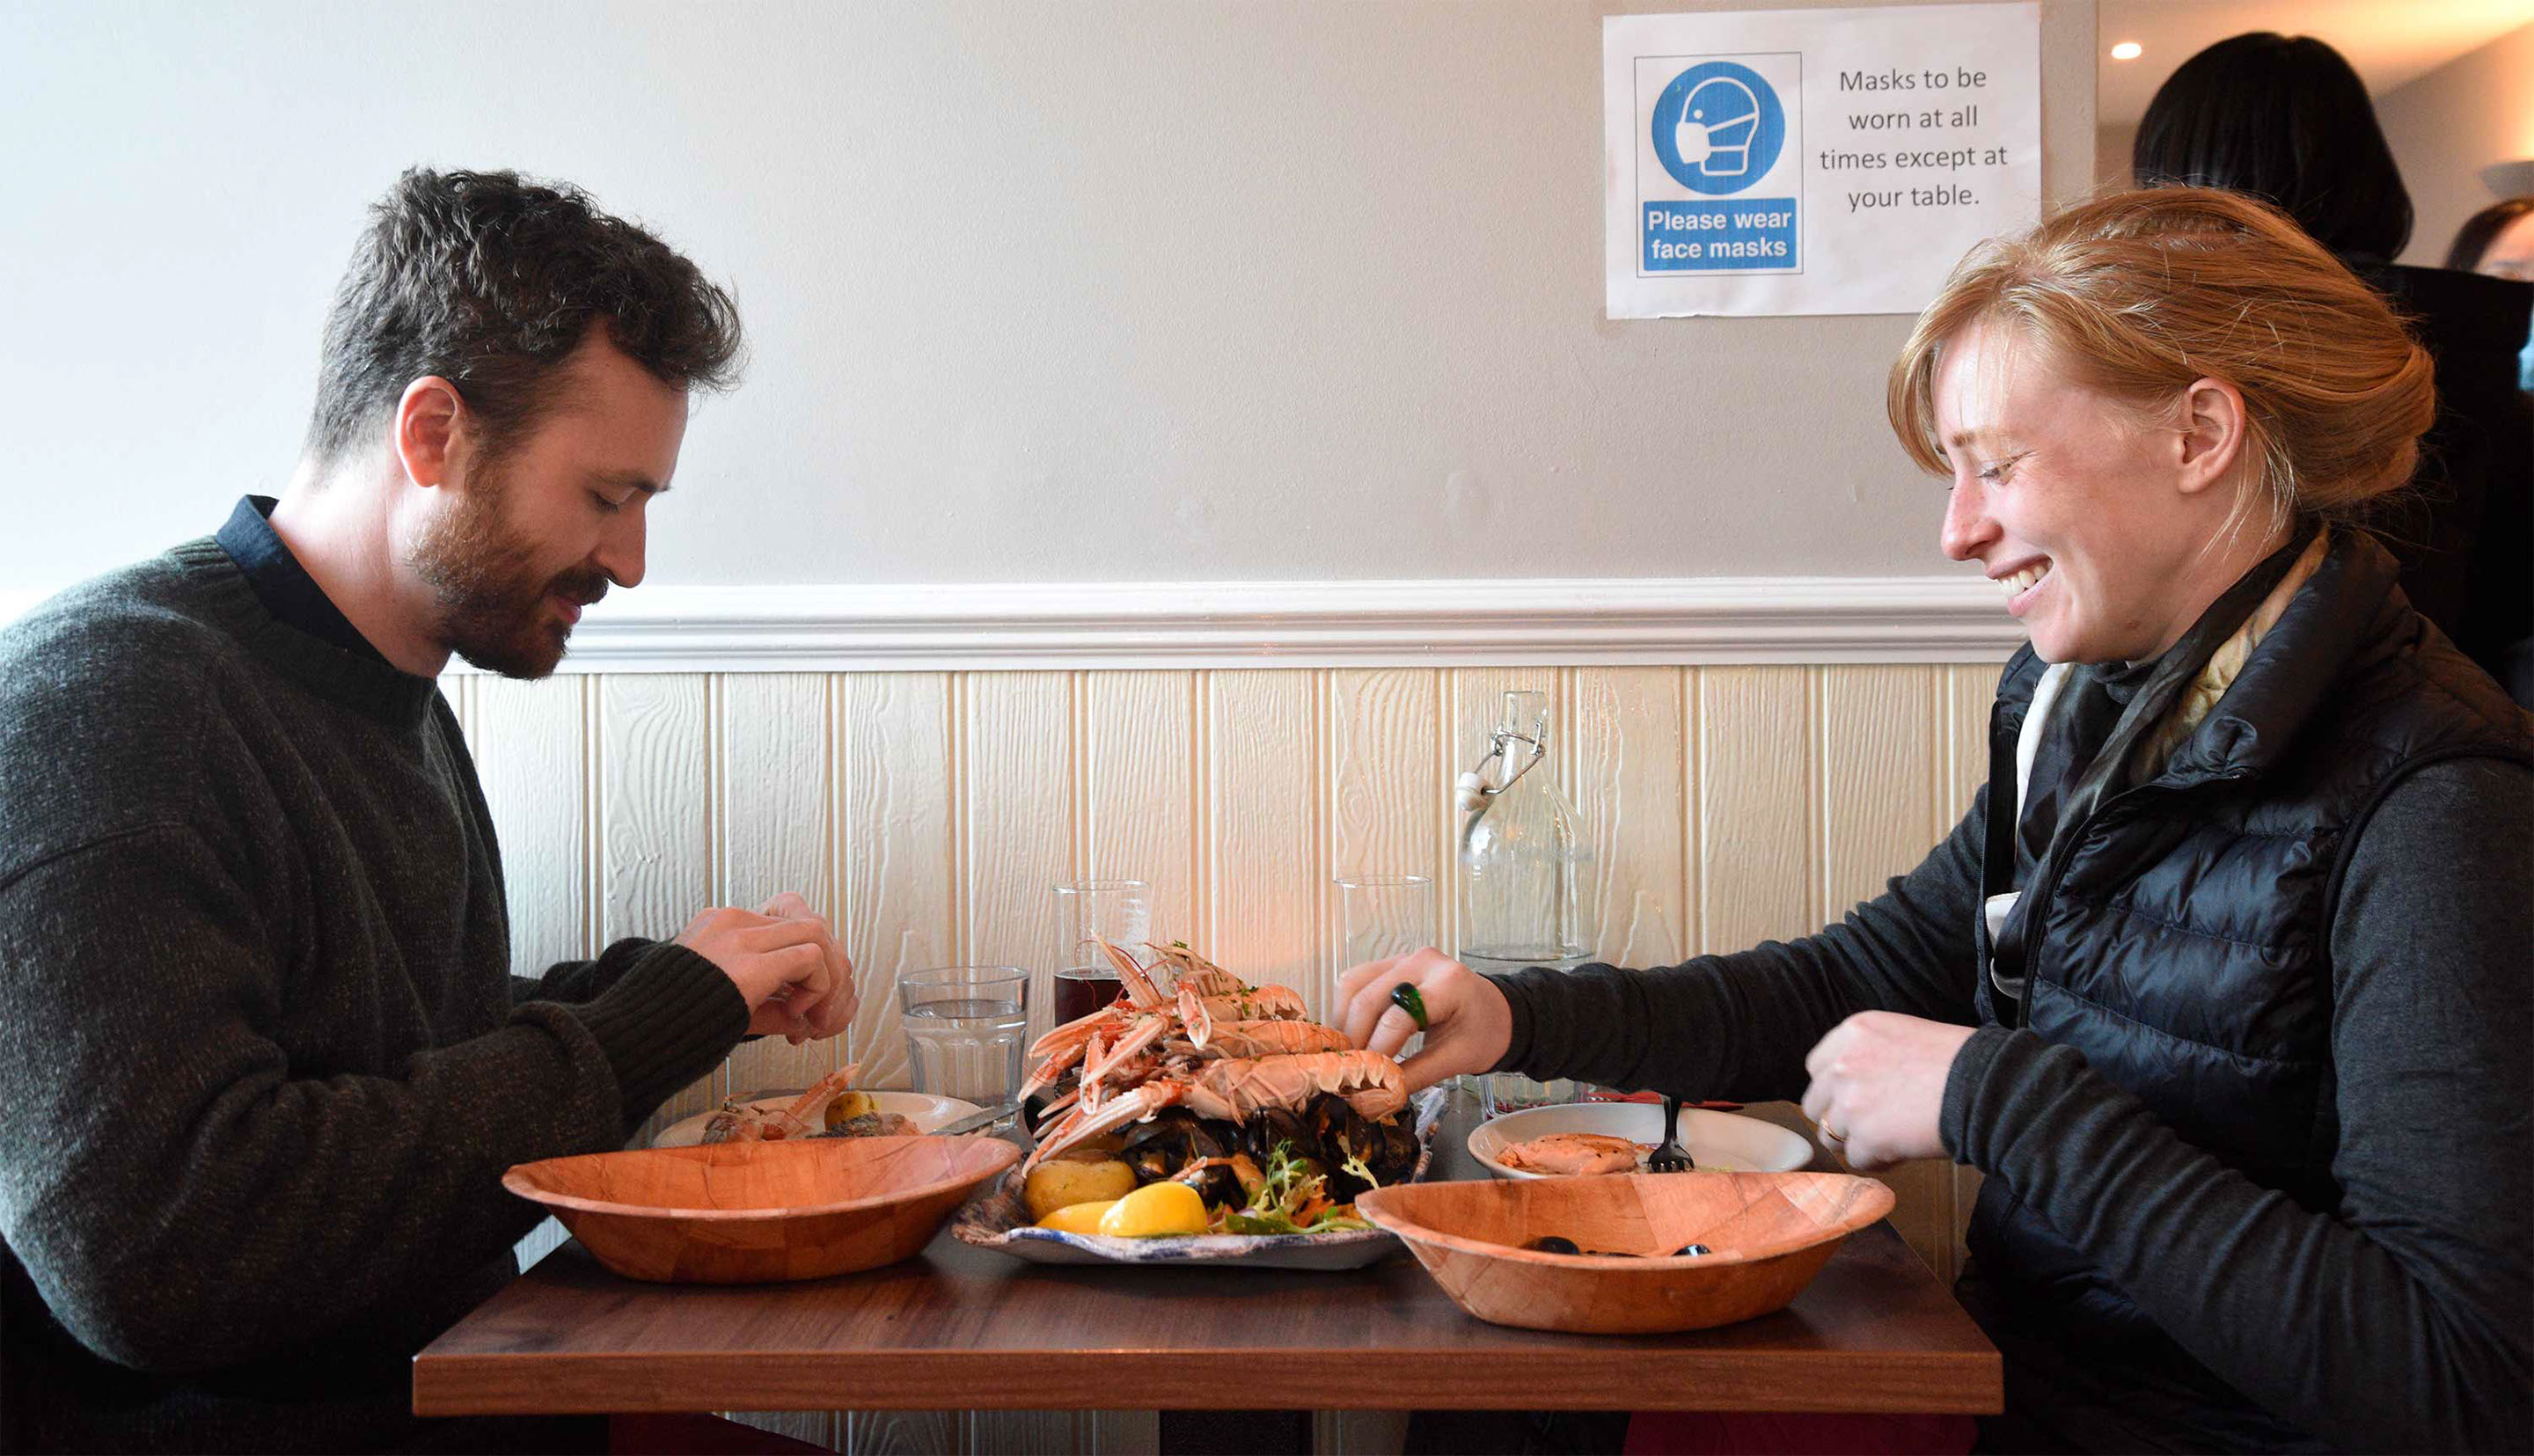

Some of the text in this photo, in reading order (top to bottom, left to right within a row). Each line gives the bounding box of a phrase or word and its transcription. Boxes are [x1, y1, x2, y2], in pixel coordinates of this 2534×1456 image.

[1841, 66, 1987, 91] Masks to be
[1849, 105, 1977, 130] worn at all
[1820, 146, 2008, 172] times except at
[1848, 184, 1979, 213] your table.
[1648, 210, 1792, 230] Please wear
[1651, 236, 1787, 260] face masks
